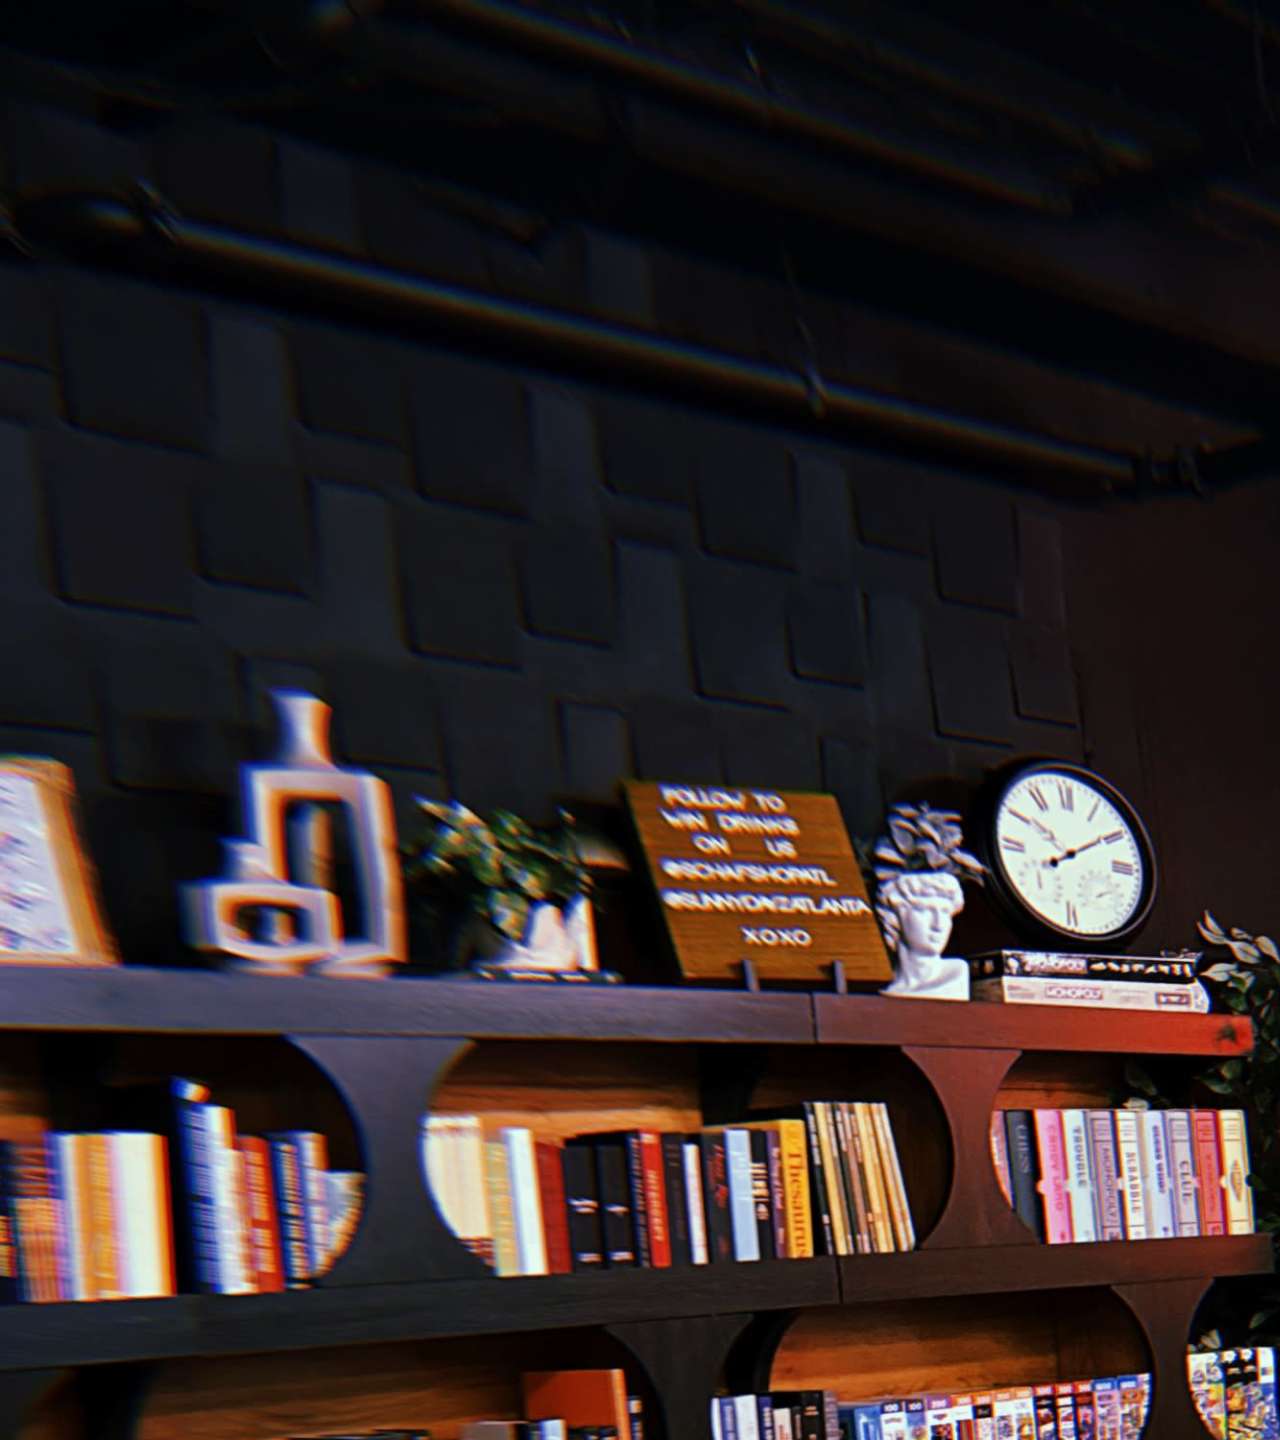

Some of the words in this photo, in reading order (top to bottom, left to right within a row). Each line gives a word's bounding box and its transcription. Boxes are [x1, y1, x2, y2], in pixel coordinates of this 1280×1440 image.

[657, 784, 747, 811] FOLLOW
[752, 789, 788, 813] TO
[658, 807, 709, 831] WIN
[715, 810, 800, 837] DRINKS
[691, 832, 732, 856] ON
[764, 836, 799, 860] US
[740, 925, 812, 948] XOXO
[1072, 1125, 1087, 1188] TROUBLE
[1125, 1152, 1141, 1214] SCRABBLE
[788, 1152, 809, 1258] Thesaurus
